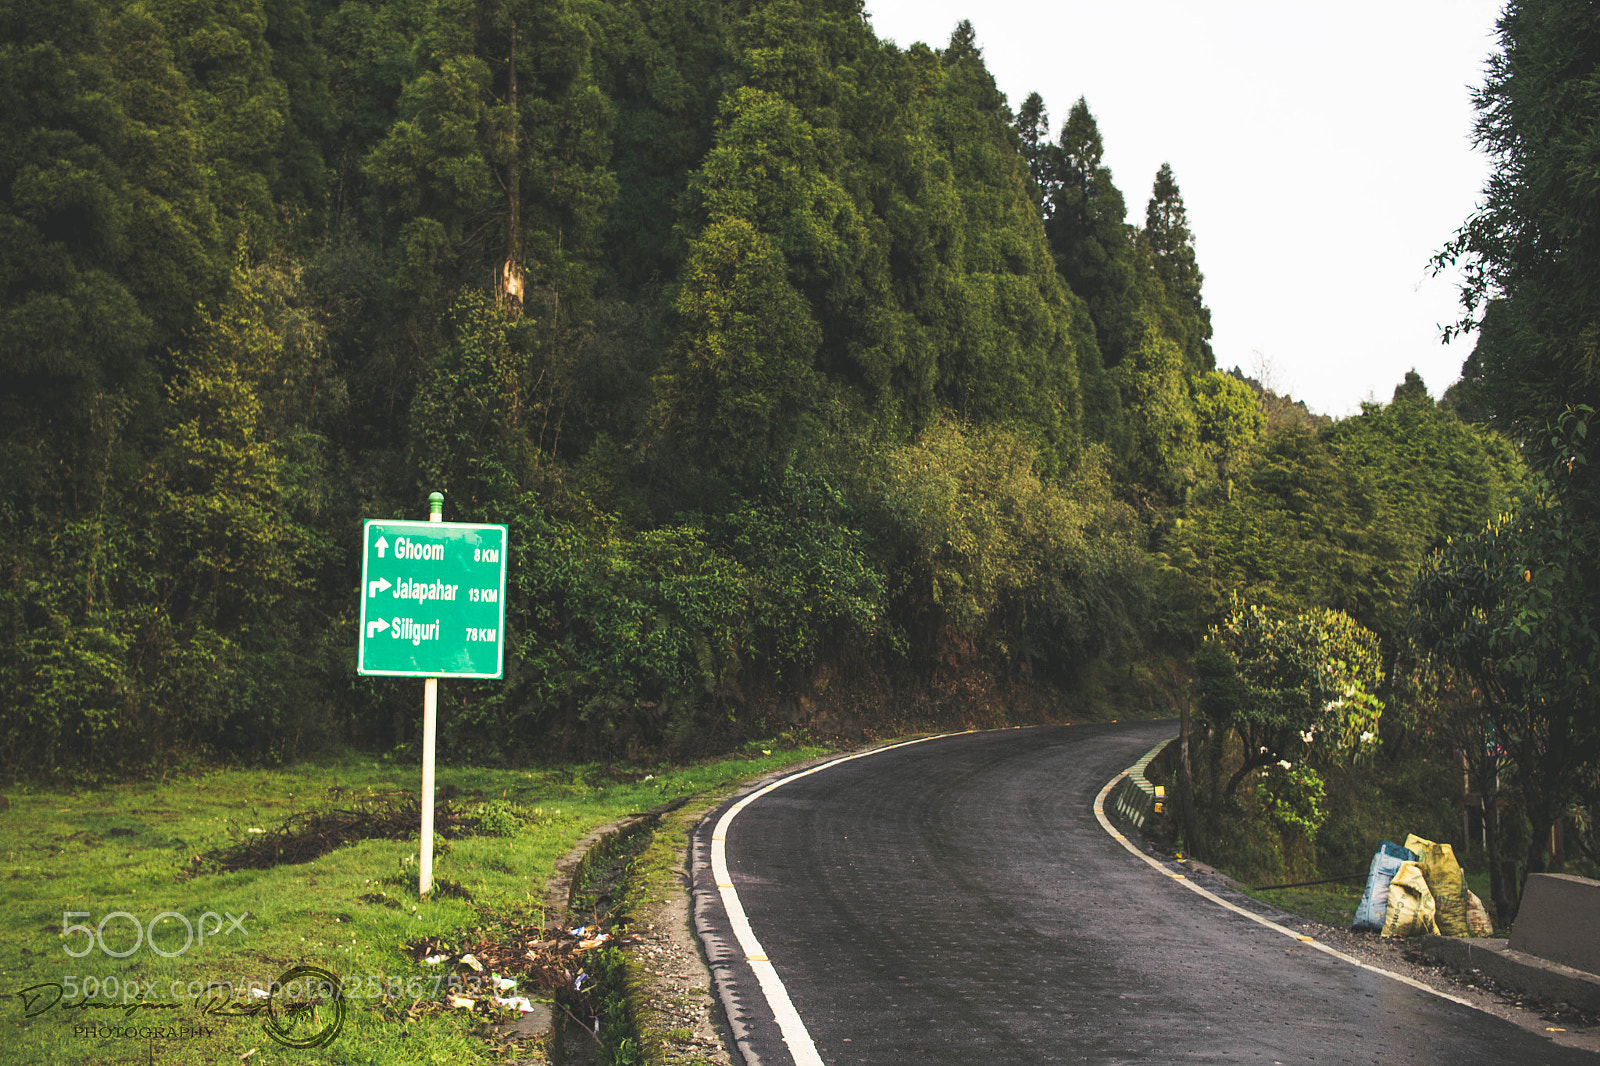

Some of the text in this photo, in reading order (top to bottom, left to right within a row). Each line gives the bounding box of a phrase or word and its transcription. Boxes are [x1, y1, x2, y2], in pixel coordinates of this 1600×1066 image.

[394, 536, 445, 561] Ghoom
[392, 576, 459, 605] Jalapahar
[390, 616, 440, 646] Siliguri
